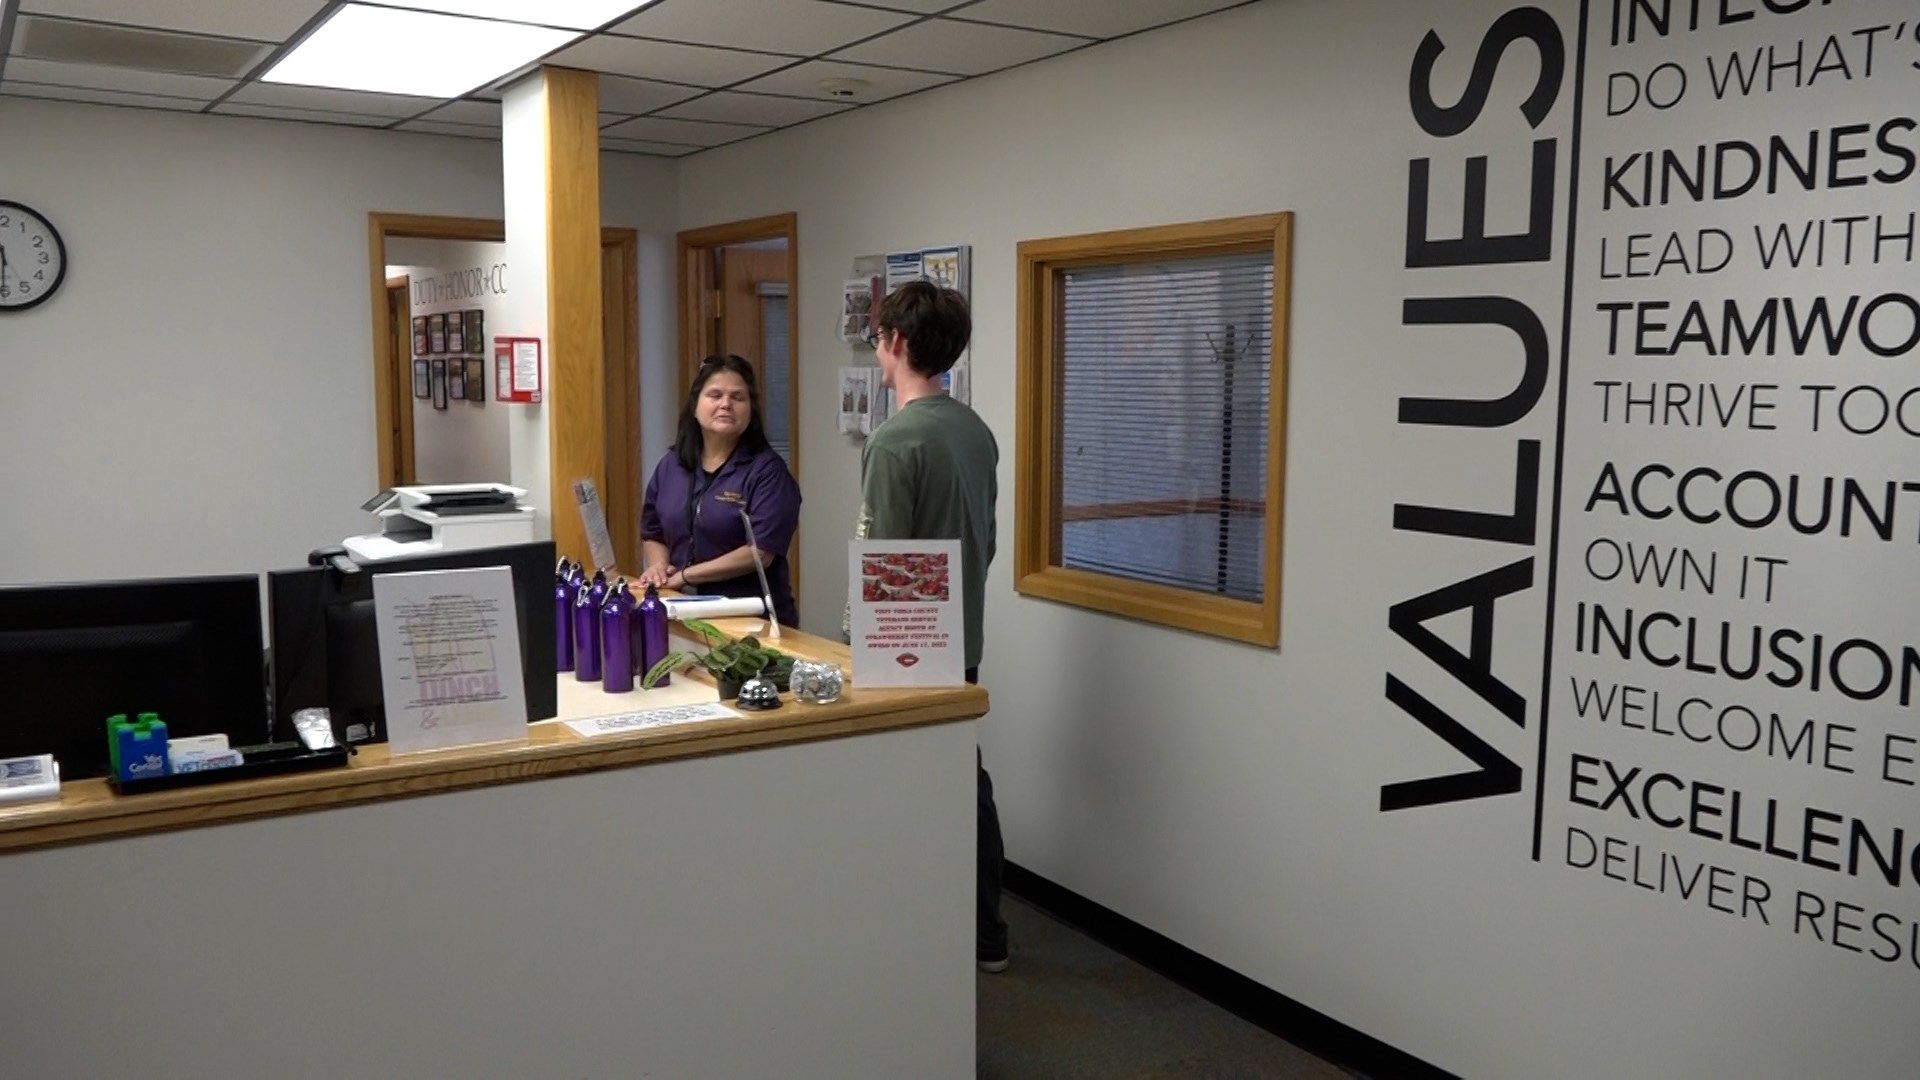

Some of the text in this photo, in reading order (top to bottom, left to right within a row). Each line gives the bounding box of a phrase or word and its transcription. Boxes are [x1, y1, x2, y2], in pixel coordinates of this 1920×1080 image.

[1606, 20, 1920, 117] DO WHAT'
[32, 234, 43, 248] 2
[38, 251, 49, 264] 3
[1600, 212, 1916, 280] LEAD WITH
[19, 281, 31, 294] 5
[33, 269, 44, 281] 4
[1595, 292, 1920, 358] TEAMWO
[1379, 7, 1565, 812] VALUES
[1592, 380, 1779, 431] THRIVE
[1584, 537, 1789, 604] OWN IT
[1570, 676, 1918, 787] WELCOME E
[1569, 751, 1920, 888] EXCELLEN
[1565, 825, 1773, 926] DELIVER
